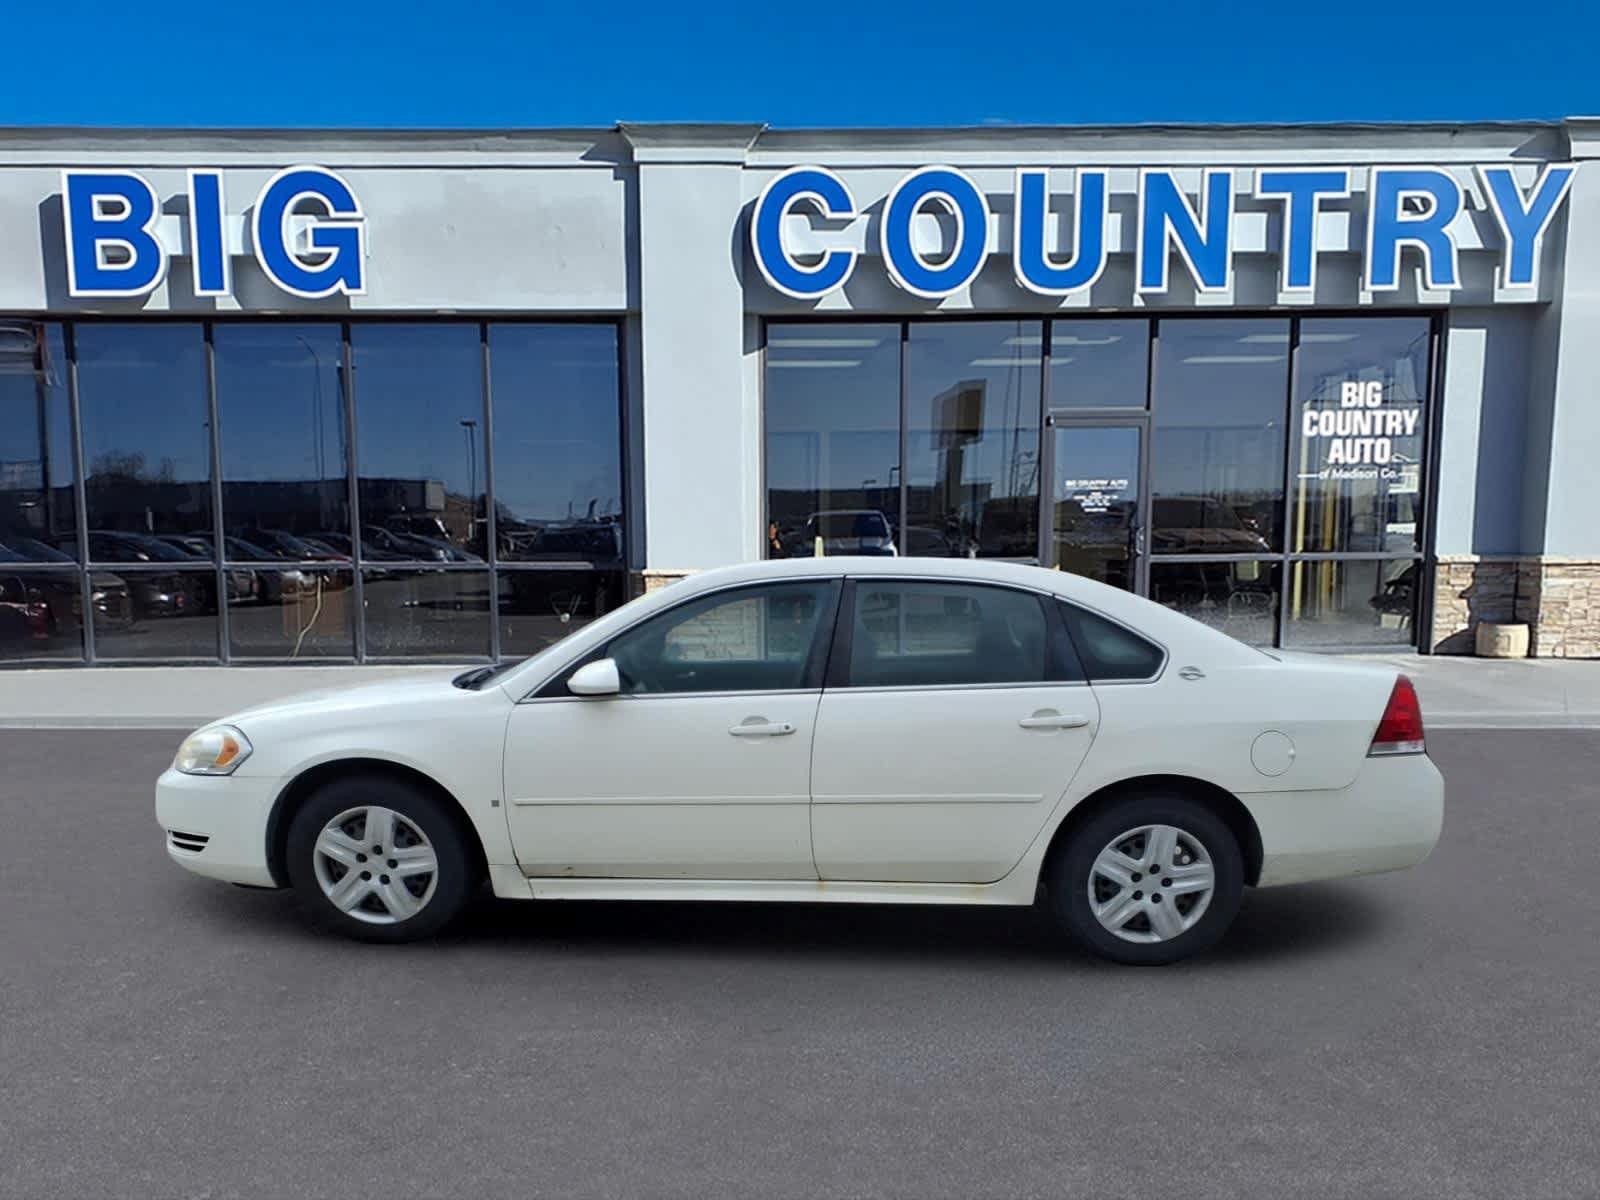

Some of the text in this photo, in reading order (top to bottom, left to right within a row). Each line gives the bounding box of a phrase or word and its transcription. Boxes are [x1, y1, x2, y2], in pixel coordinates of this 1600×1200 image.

[60, 163, 1576, 299] BIG COUNTRY
[1341, 381, 1382, 408] BIG
[1303, 409, 1419, 436] COUNTRY
[1328, 437, 1391, 464] AUTO
[1319, 467, 1399, 480] of Madison Co.
